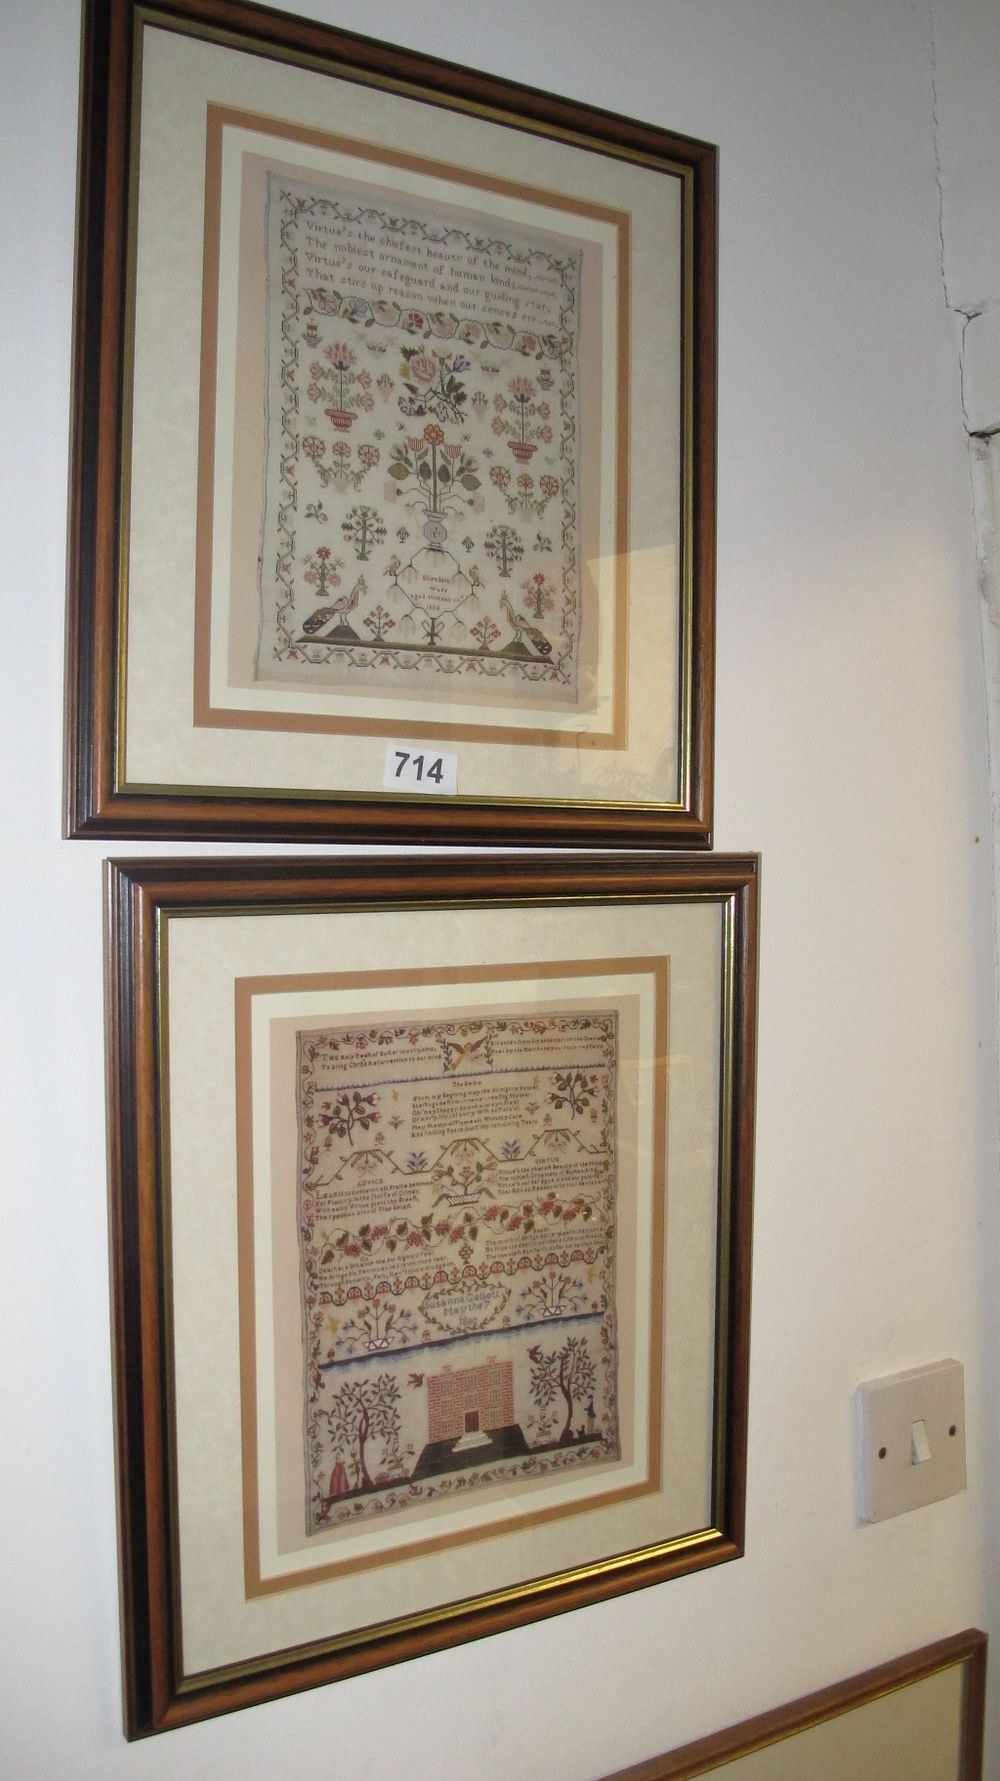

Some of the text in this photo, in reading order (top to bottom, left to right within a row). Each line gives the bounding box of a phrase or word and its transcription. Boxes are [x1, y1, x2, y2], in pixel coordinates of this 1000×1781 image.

[305, 236, 328, 249] The
[335, 243, 375, 258] noblest
[379, 253, 429, 271] ornament
[433, 265, 445, 275] of
[450, 267, 485, 281] human
[306, 221, 354, 237] Virtue's
[358, 231, 376, 243] the
[467, 255, 479, 265] of
[483, 259, 500, 270] the
[305, 252, 352, 270] Virtue's
[358, 263, 376, 275] our
[440, 282, 459, 293] and
[463, 287, 480, 297] our
[485, 290, 520, 309] guiding
[305, 268, 334, 281] That
[370, 284, 383, 296] up
[388, 287, 423, 301] reason
[427, 295, 456, 307] when
[459, 301, 477, 311] our
[395, 751, 444, 784] 714
